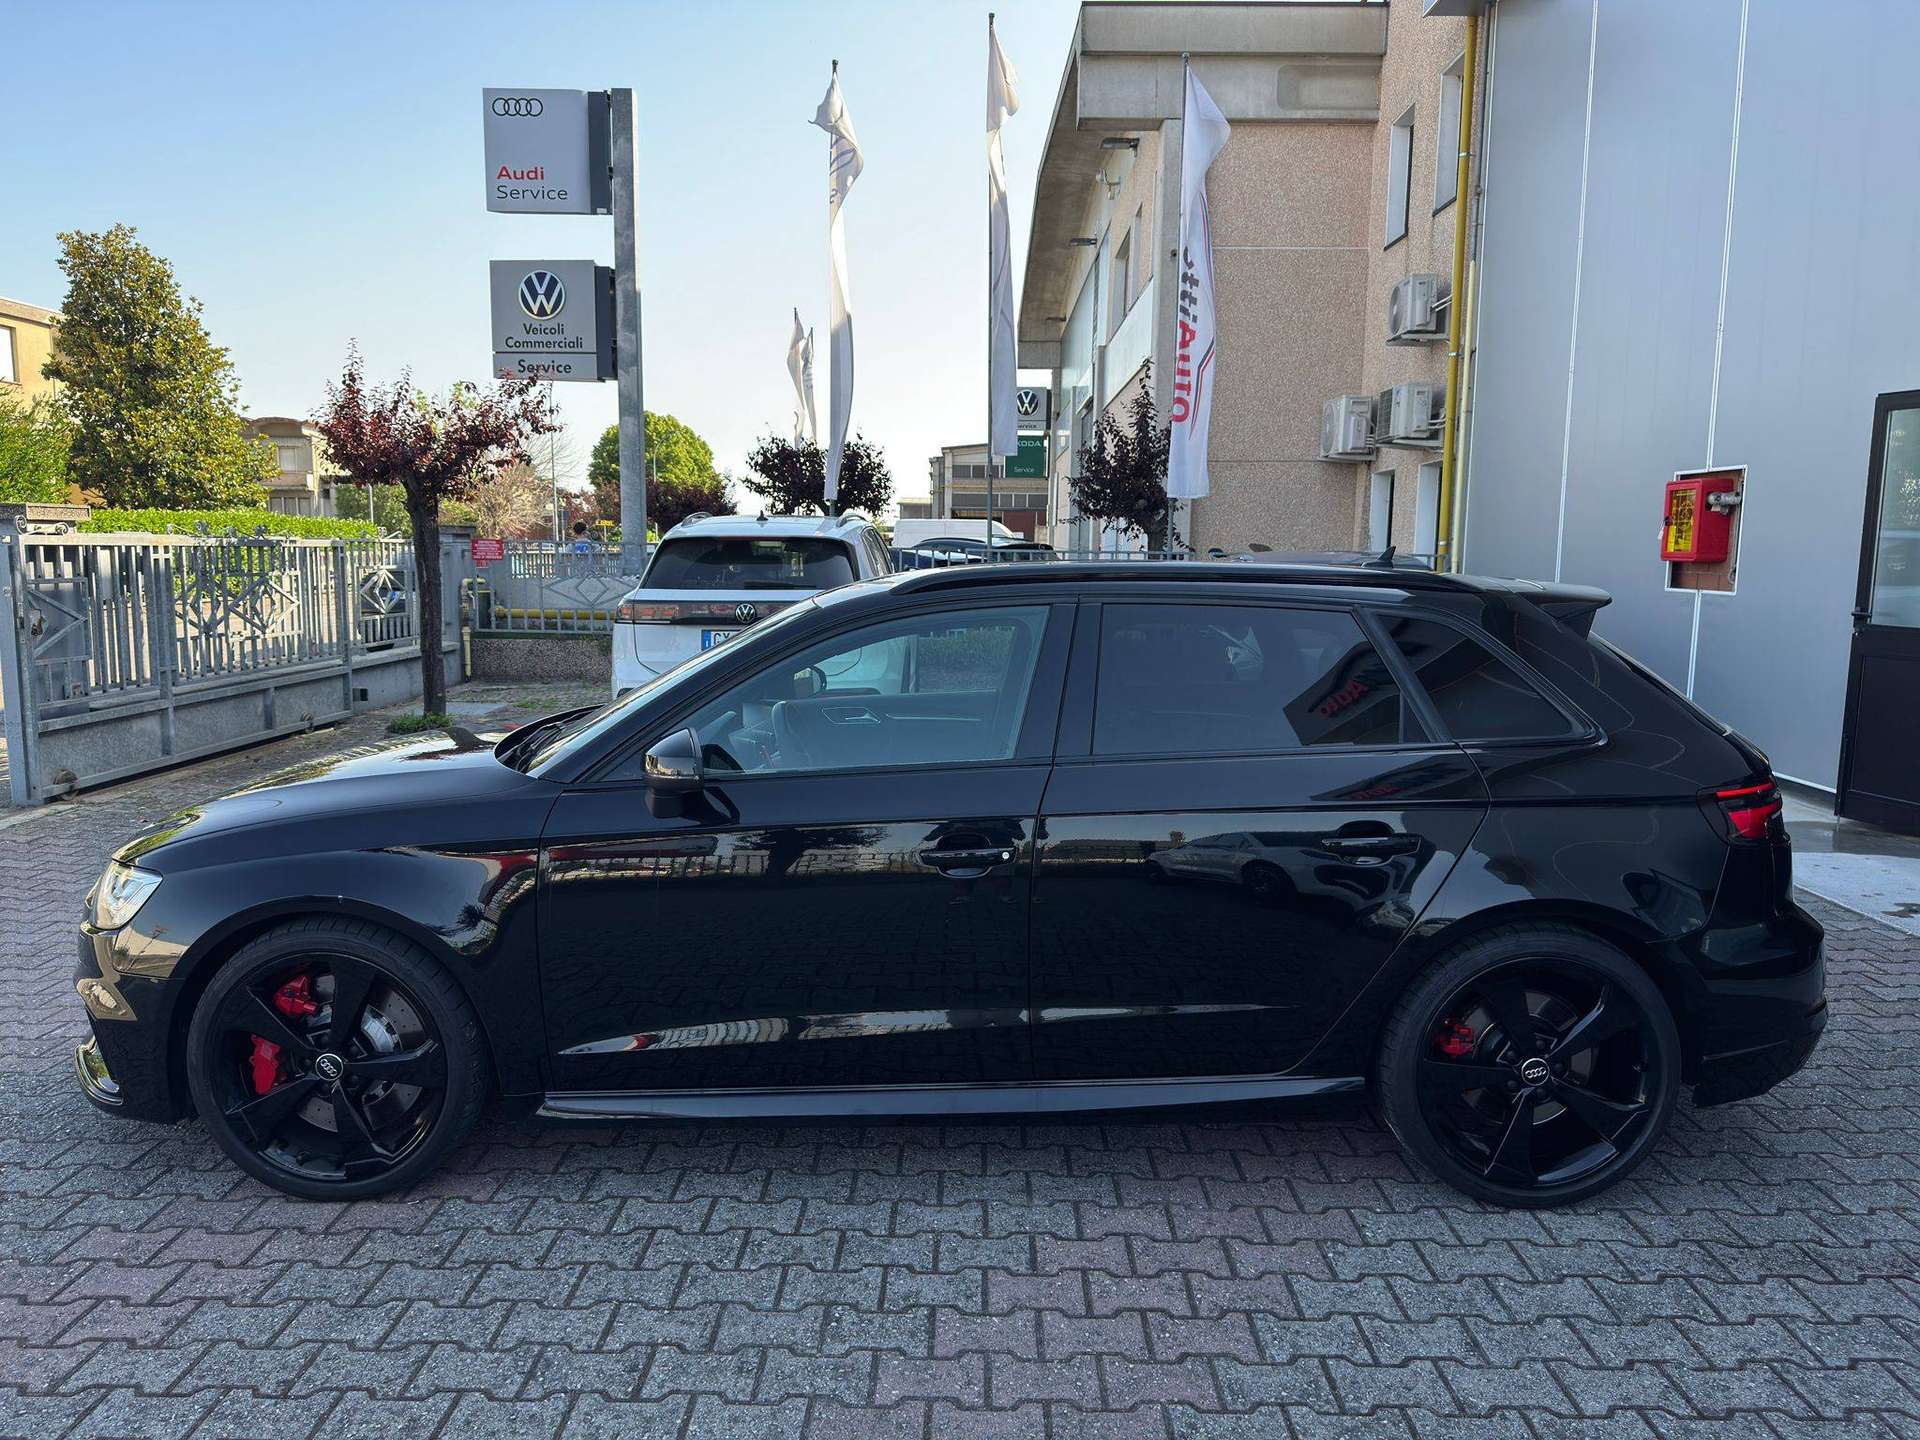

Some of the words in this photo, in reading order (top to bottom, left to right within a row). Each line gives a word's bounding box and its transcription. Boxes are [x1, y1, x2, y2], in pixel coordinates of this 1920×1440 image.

[496, 165, 545, 181] Audi
[496, 185, 568, 200] Service
[522, 323, 565, 335] Veicoli
[505, 336, 583, 349] Commerciali
[517, 359, 572, 374] Service
